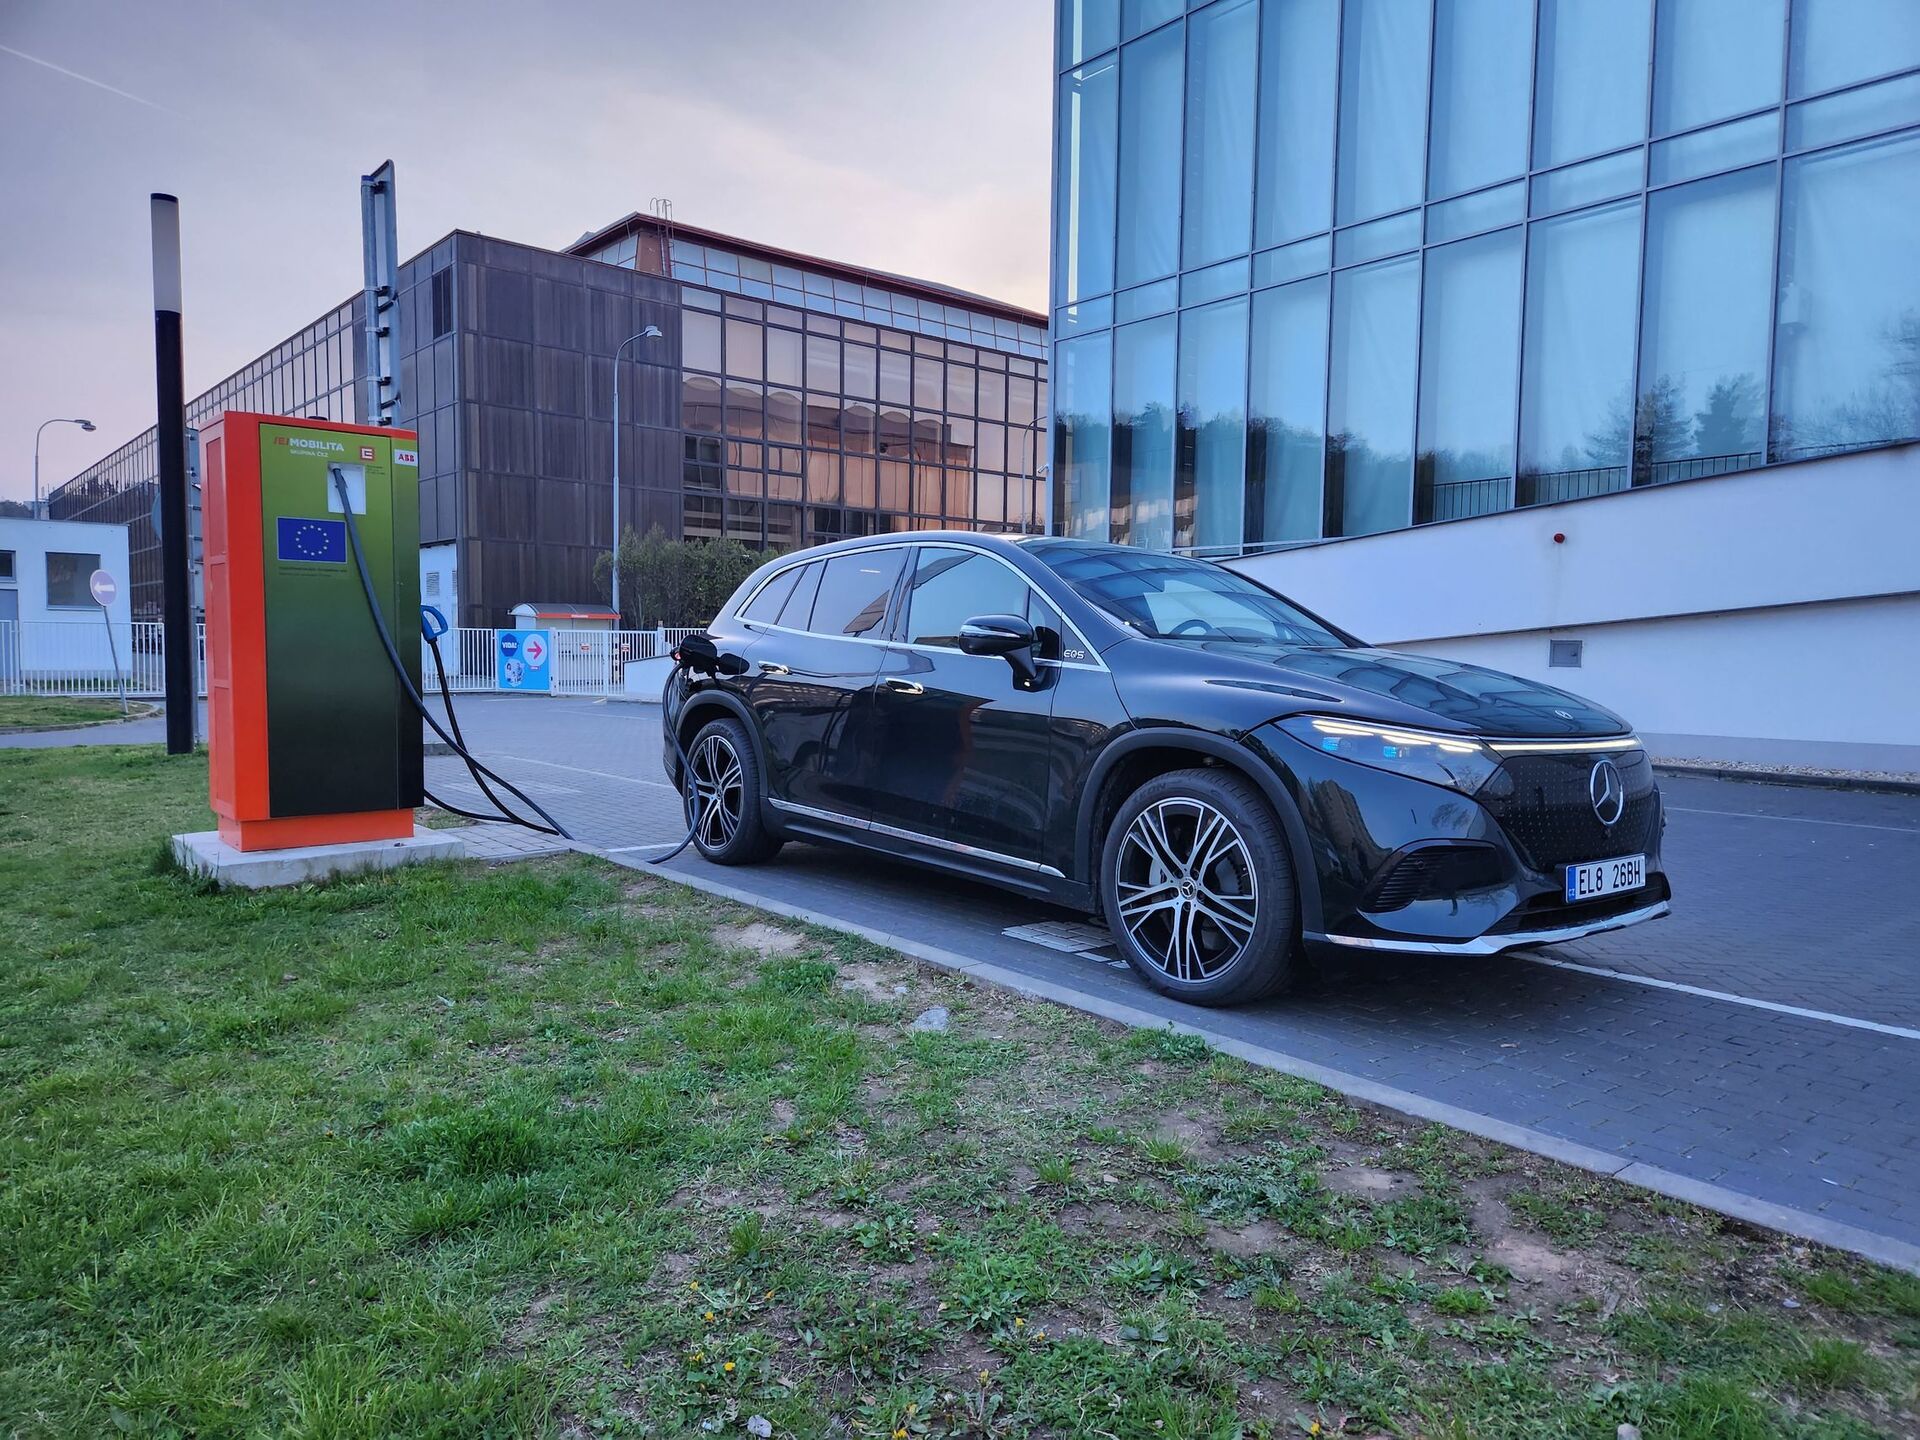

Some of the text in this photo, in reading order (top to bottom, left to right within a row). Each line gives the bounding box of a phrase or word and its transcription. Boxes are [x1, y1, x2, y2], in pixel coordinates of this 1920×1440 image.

[398, 453, 415, 463] ABB
[1064, 649, 1084, 659] EQS
[1579, 860, 1640, 895] EL8 26BH
